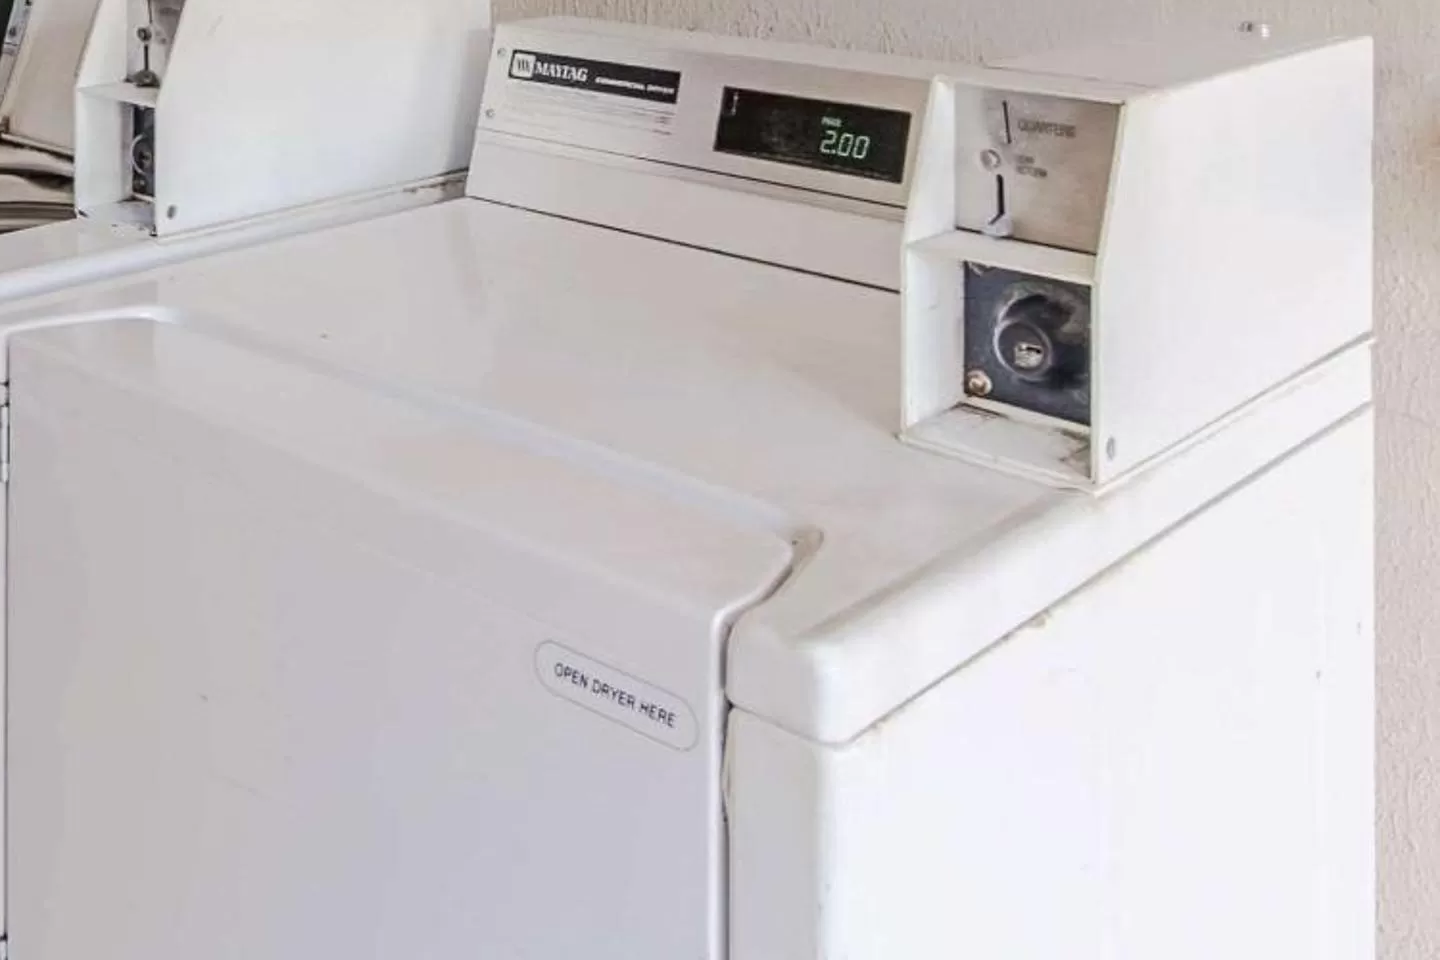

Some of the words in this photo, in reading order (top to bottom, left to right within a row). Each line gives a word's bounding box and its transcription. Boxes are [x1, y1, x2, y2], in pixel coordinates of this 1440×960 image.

[536, 61, 588, 82] MAYTAG
[820, 130, 870, 159] 2.00
[554, 662, 589, 688] OPEN
[592, 679, 636, 711] DRYER
[639, 702, 677, 728] HERE
